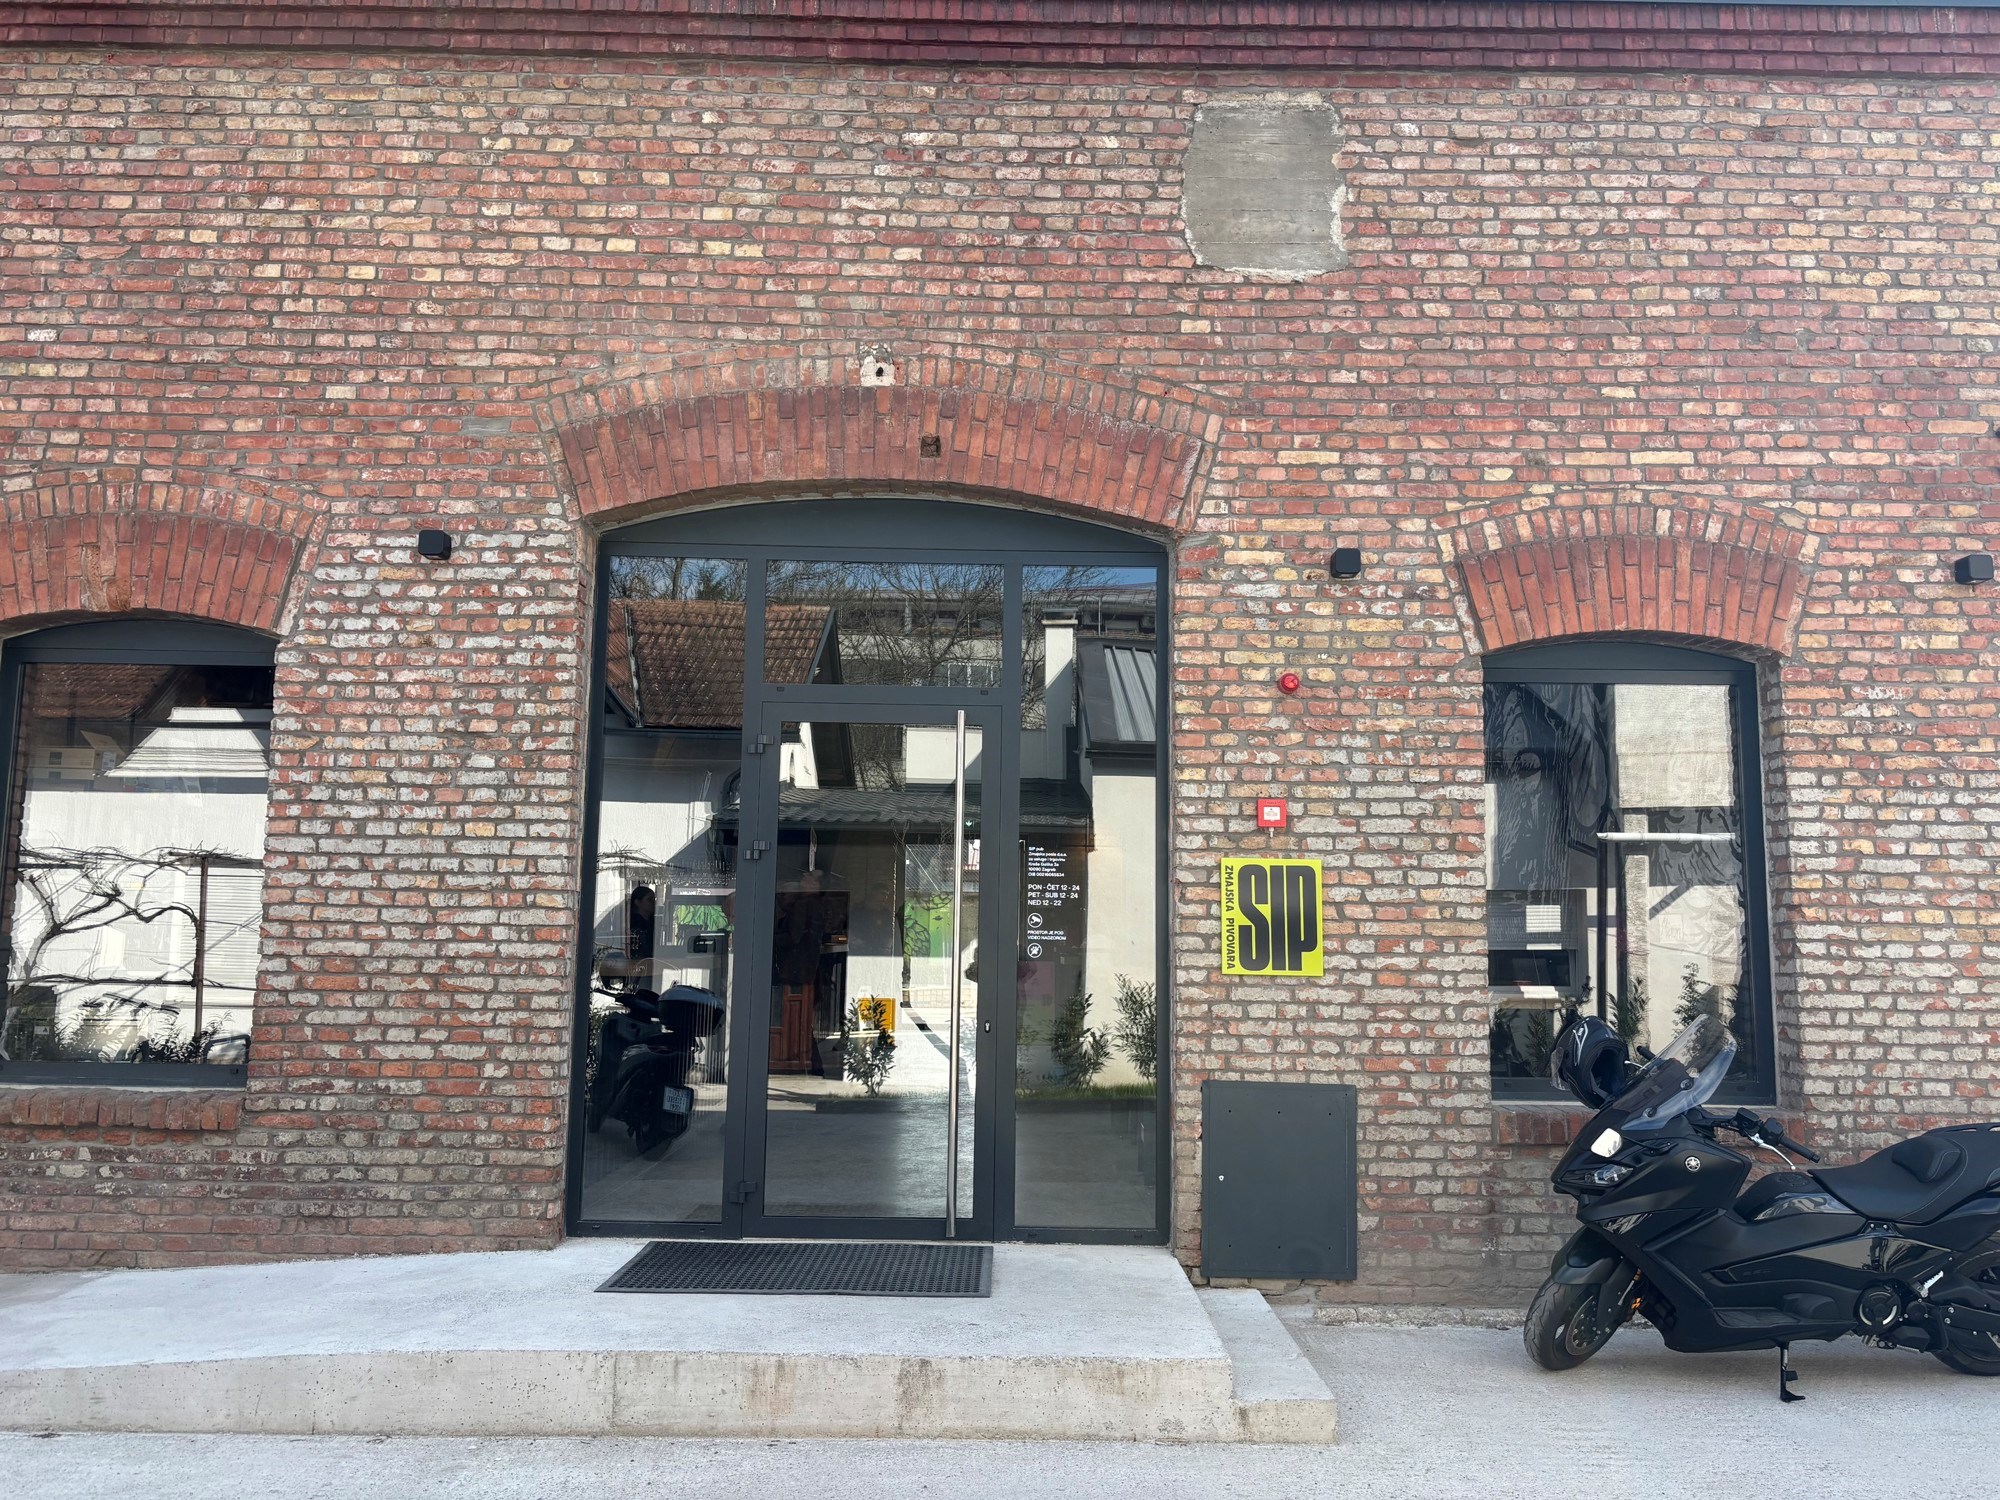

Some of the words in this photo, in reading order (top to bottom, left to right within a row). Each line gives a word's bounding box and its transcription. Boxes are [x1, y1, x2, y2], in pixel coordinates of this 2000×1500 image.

[1225, 865, 1234, 912] ZMAJSKA
[1238, 864, 1318, 971] SIP
[1226, 918, 1235, 969] PIVOVARA
